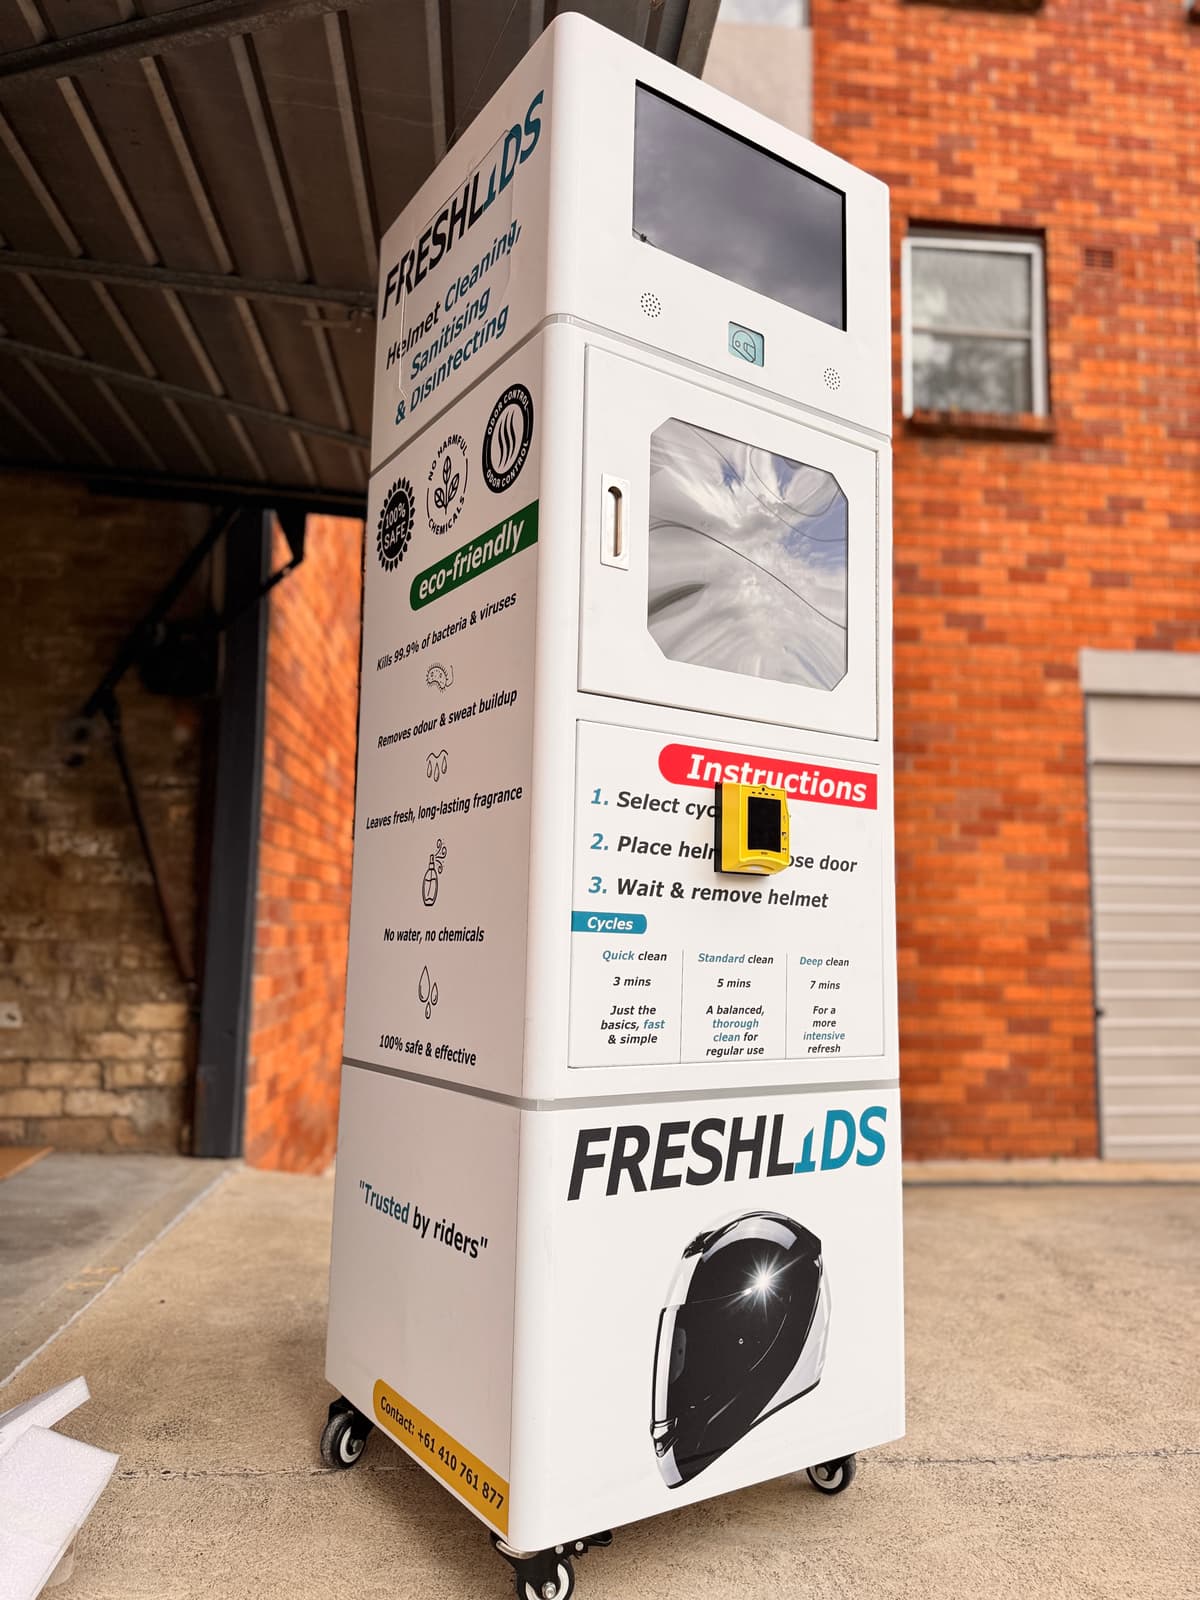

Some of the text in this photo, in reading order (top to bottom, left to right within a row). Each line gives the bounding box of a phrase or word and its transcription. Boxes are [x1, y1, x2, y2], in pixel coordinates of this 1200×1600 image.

[386, 219, 522, 370] Helmet Cleaning,
[410, 287, 491, 380] Sanitising
[395, 399, 407, 425] &
[428, 433, 468, 481] NO HARMFUL
[384, 502, 407, 530] 100%
[428, 495, 465, 536] CHEMICALS
[383, 520, 407, 551] SAFE
[418, 517, 526, 601] eco-friendly
[376, 592, 517, 671] Kills 99.9% of bacteria & viruses
[377, 688, 518, 749] Removes odour & sweat buildup
[686, 753, 868, 803] Instructions
[366, 785, 523, 830] Leaves fresh, long-lasting fragrance
[590, 788, 609, 806] 1.
[616, 791, 679, 814] Select
[590, 833, 609, 851] 2.
[617, 836, 672, 857] Place
[819, 854, 858, 873] door
[588, 876, 829, 909] 3. Wait & remove helmet
[587, 916, 634, 933] Cycles
[383, 926, 485, 944] No water, no chemicals
[602, 950, 668, 963] Quick clean
[697, 953, 774, 966] Standard clean
[799, 956, 850, 968] Deep clean
[612, 976, 651, 987] 3 mins
[716, 978, 752, 989] 5 mins
[809, 980, 841, 991] 7 mins
[609, 1004, 657, 1017] Just the
[705, 1004, 765, 1017] A balanced,
[812, 1005, 837, 1016] For a
[600, 1017, 666, 1032] basics, fast
[712, 1018, 760, 1031] thorough
[812, 1019, 837, 1029] more
[607, 1032, 658, 1047] & simple
[712, 1030, 759, 1043] clean for
[803, 1030, 846, 1042] intensive
[379, 1034, 477, 1066] 100% safe & effective
[705, 1044, 765, 1058] regular use
[807, 1043, 842, 1055] refresh
[359, 1179, 489, 1260] "Trusted by riders"
[380, 1395, 505, 1511] Contact: +61 410 761 877
